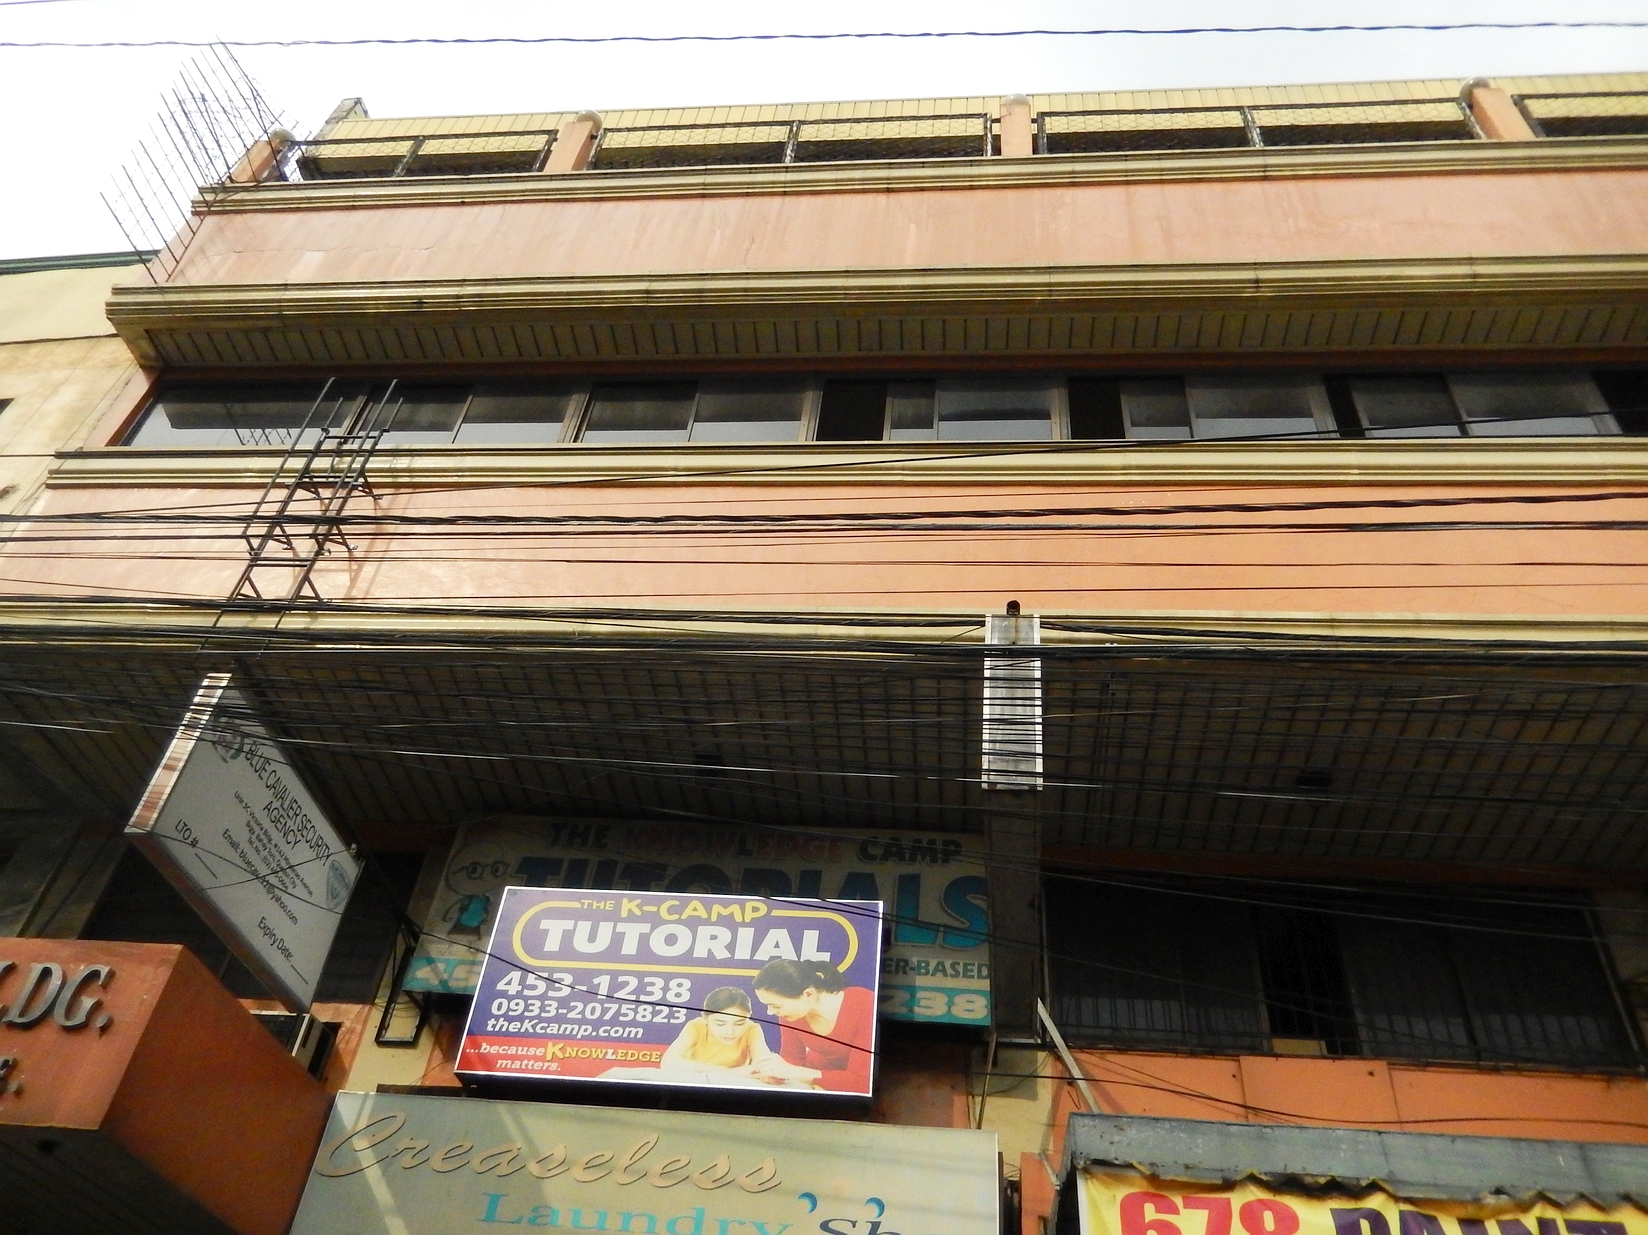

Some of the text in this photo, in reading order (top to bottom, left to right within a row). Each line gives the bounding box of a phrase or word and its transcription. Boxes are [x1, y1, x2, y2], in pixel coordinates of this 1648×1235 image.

[245, 740, 333, 866] BLUE CAVALIER SECURITY
[262, 800, 302, 849] AGENCY
[175, 819, 192, 844] LTO
[551, 822, 614, 849] THE
[859, 837, 962, 865] CAMP
[580, 898, 768, 923] THE K-CAMP
[257, 916, 294, 963] Expiry Date:
[538, 919, 832, 962] TUTORIAL
[0, 960, 112, 1030] DG.
[496, 971, 692, 1003] 453-1238
[485, 1017, 644, 1039] theKcamp.com
[490, 998, 688, 1024] 0933-2075823
[496, 1058, 562, 1071] matters.
[545, 1041, 662, 1063] KNOWLEDGE
[314, 1110, 782, 1193] Creaseless
[476, 1192, 794, 1235] Laundry
